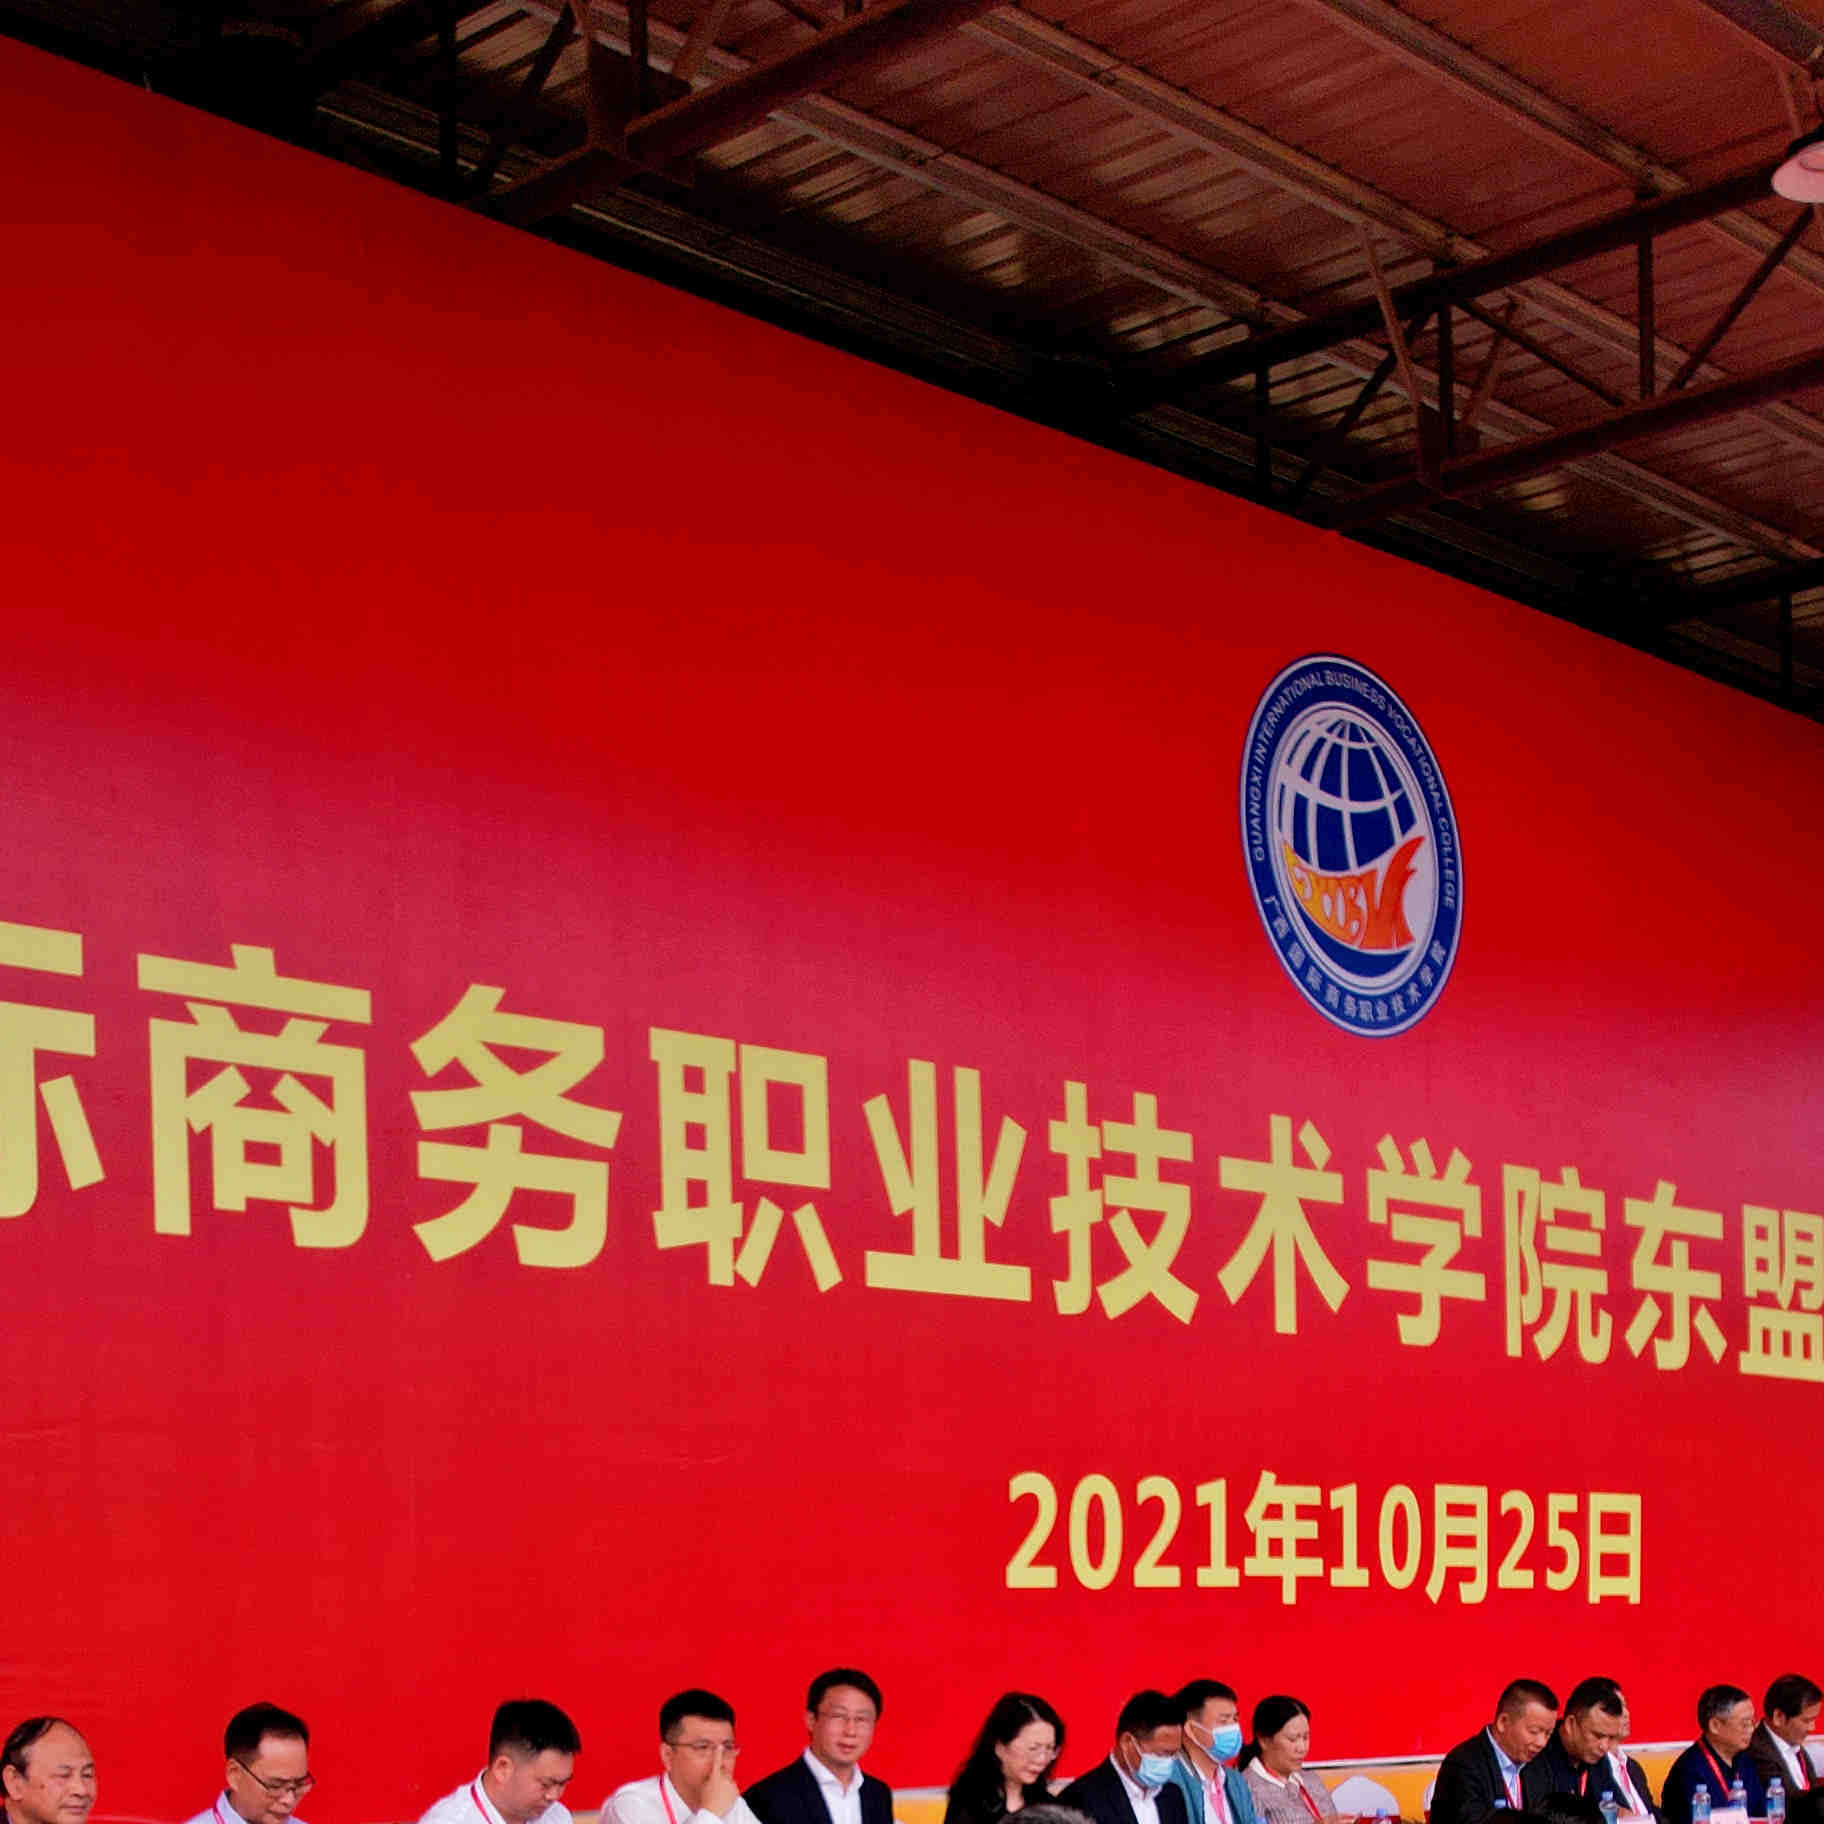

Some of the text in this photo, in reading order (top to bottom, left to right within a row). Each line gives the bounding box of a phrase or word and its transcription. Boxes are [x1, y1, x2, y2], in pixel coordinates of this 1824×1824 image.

[1256, 670, 1326, 762] INTERNATIONAL
[1325, 669, 1387, 710] BUSINESS
[1438, 816, 1459, 910] COLLEGE
[1005, 1470, 1642, 1604] 2021年10月25日
